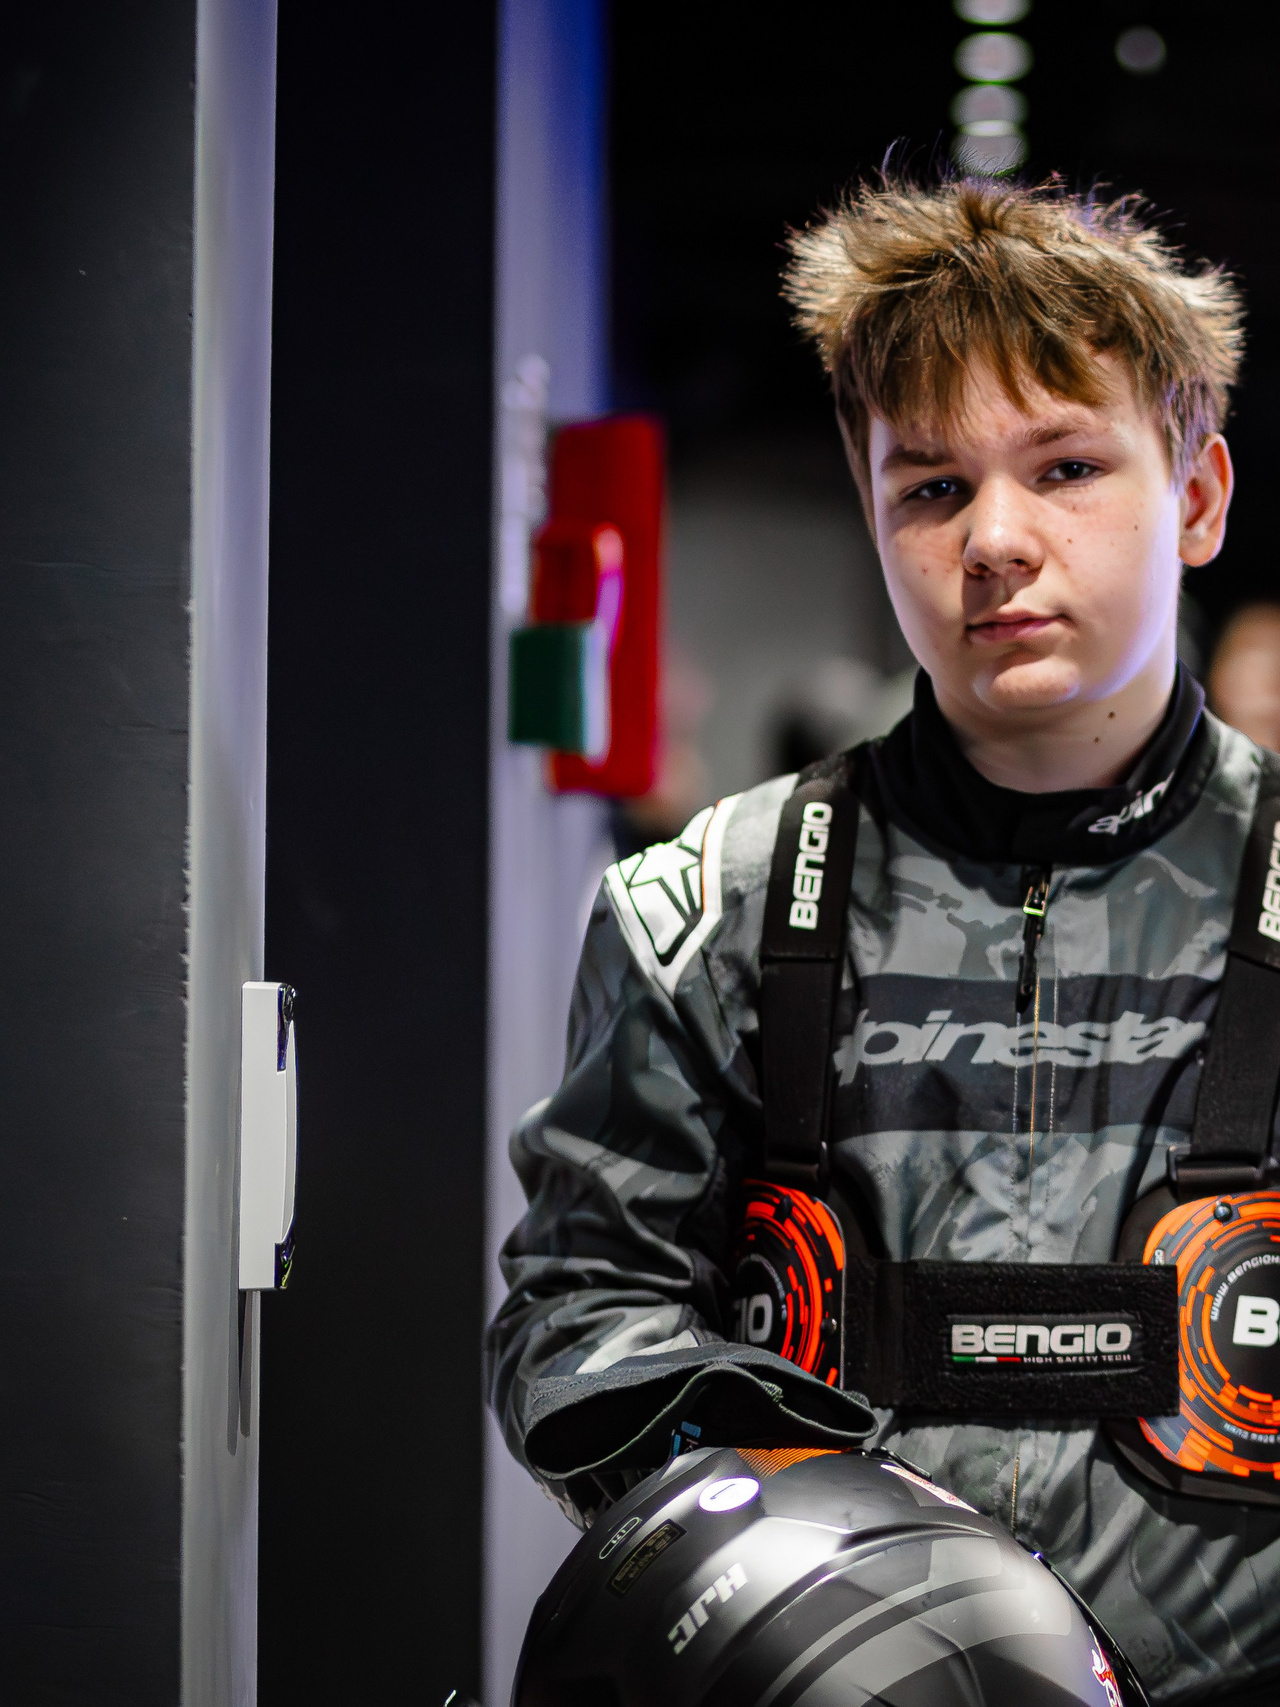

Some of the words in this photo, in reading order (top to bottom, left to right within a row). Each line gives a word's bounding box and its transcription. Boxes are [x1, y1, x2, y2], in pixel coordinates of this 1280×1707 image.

[789, 802, 832, 930] BENGIO
[951, 1323, 1132, 1355] BENGIO
[1055, 1356, 1099, 1364] SAFETY
[667, 1562, 749, 1655] HJC
